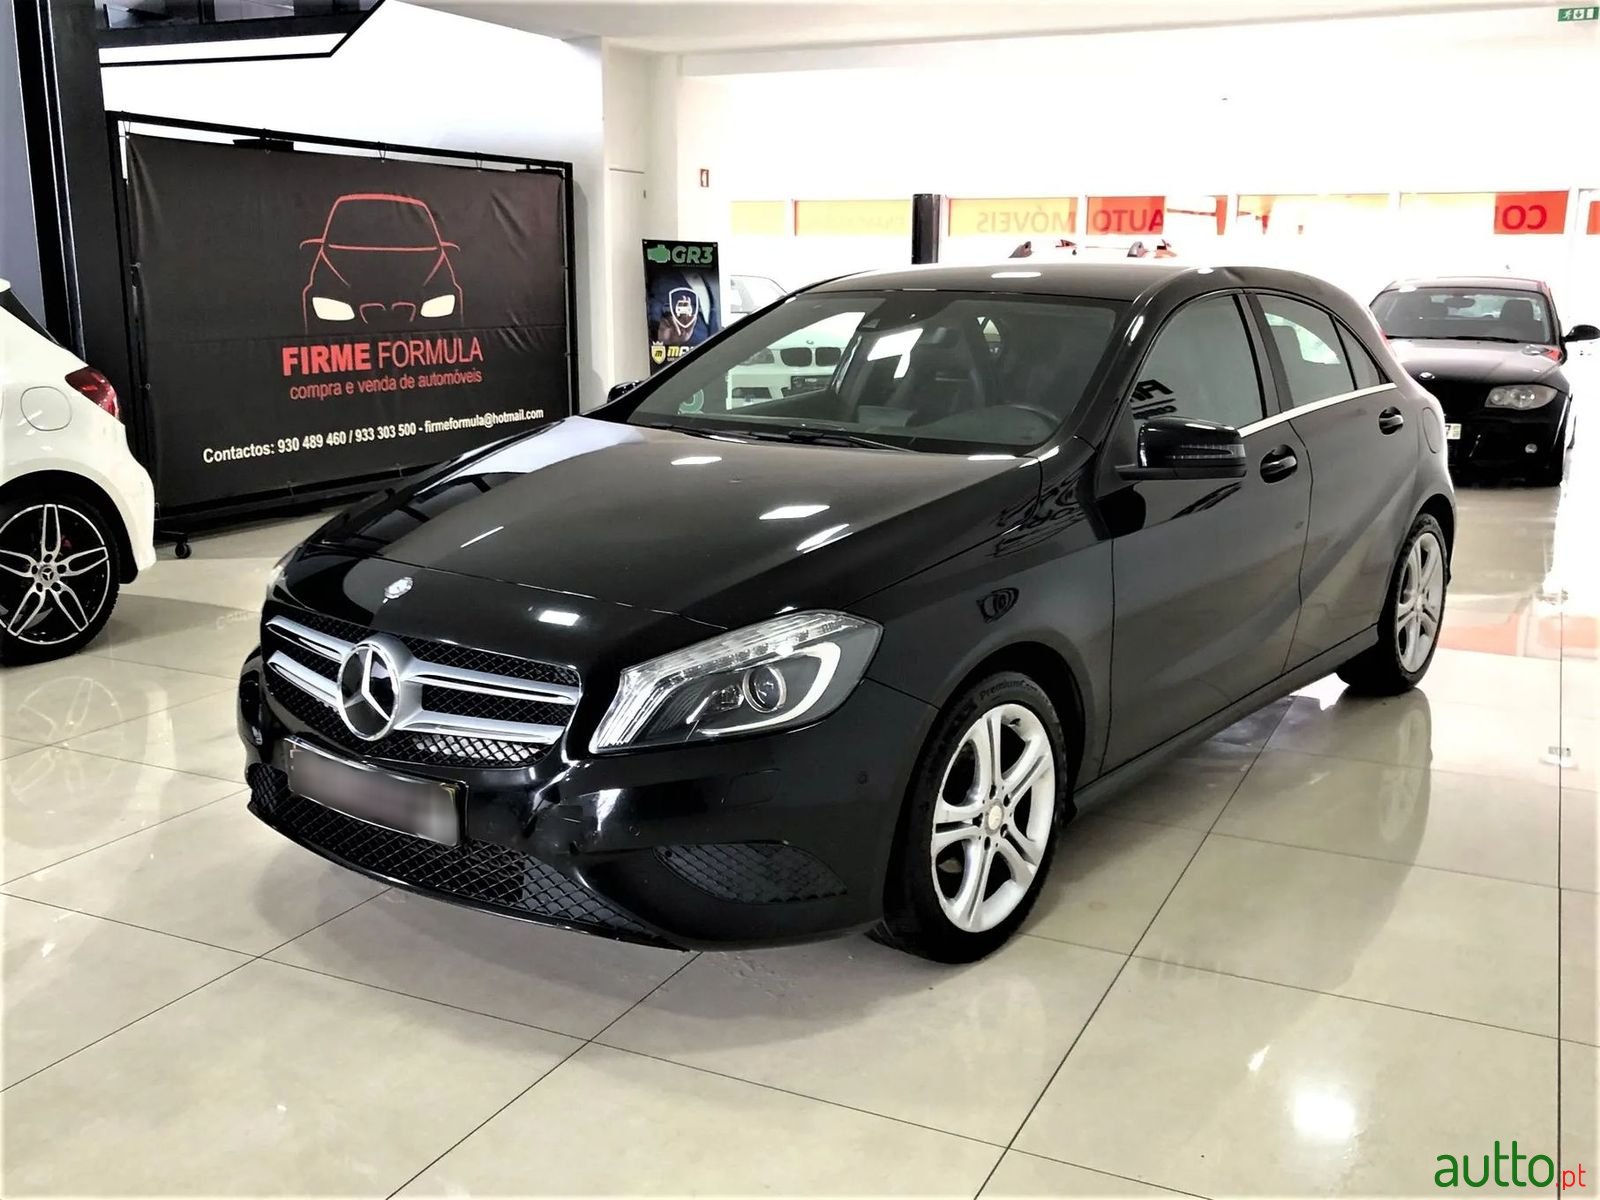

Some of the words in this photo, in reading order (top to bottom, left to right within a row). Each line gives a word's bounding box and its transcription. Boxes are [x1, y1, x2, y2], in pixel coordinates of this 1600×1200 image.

[671, 245, 713, 264] GR3
[282, 343, 372, 376] FIRME
[378, 337, 484, 369] FORMULA
[289, 380, 342, 401] compra
[345, 381, 354, 395] e
[357, 375, 398, 392] venda
[400, 374, 415, 389] de
[418, 368, 482, 388] automóveis
[203, 443, 275, 464] Contactos:
[277, 437, 300, 454] 930
[302, 434, 324, 450] 489
[326, 431, 347, 447] 460
[349, 429, 354, 444] /
[354, 427, 375, 442] 933
[377, 425, 396, 440] 303
[398, 422, 417, 437] 500
[424, 409, 544, 433] firmeformula@hotmail.com
